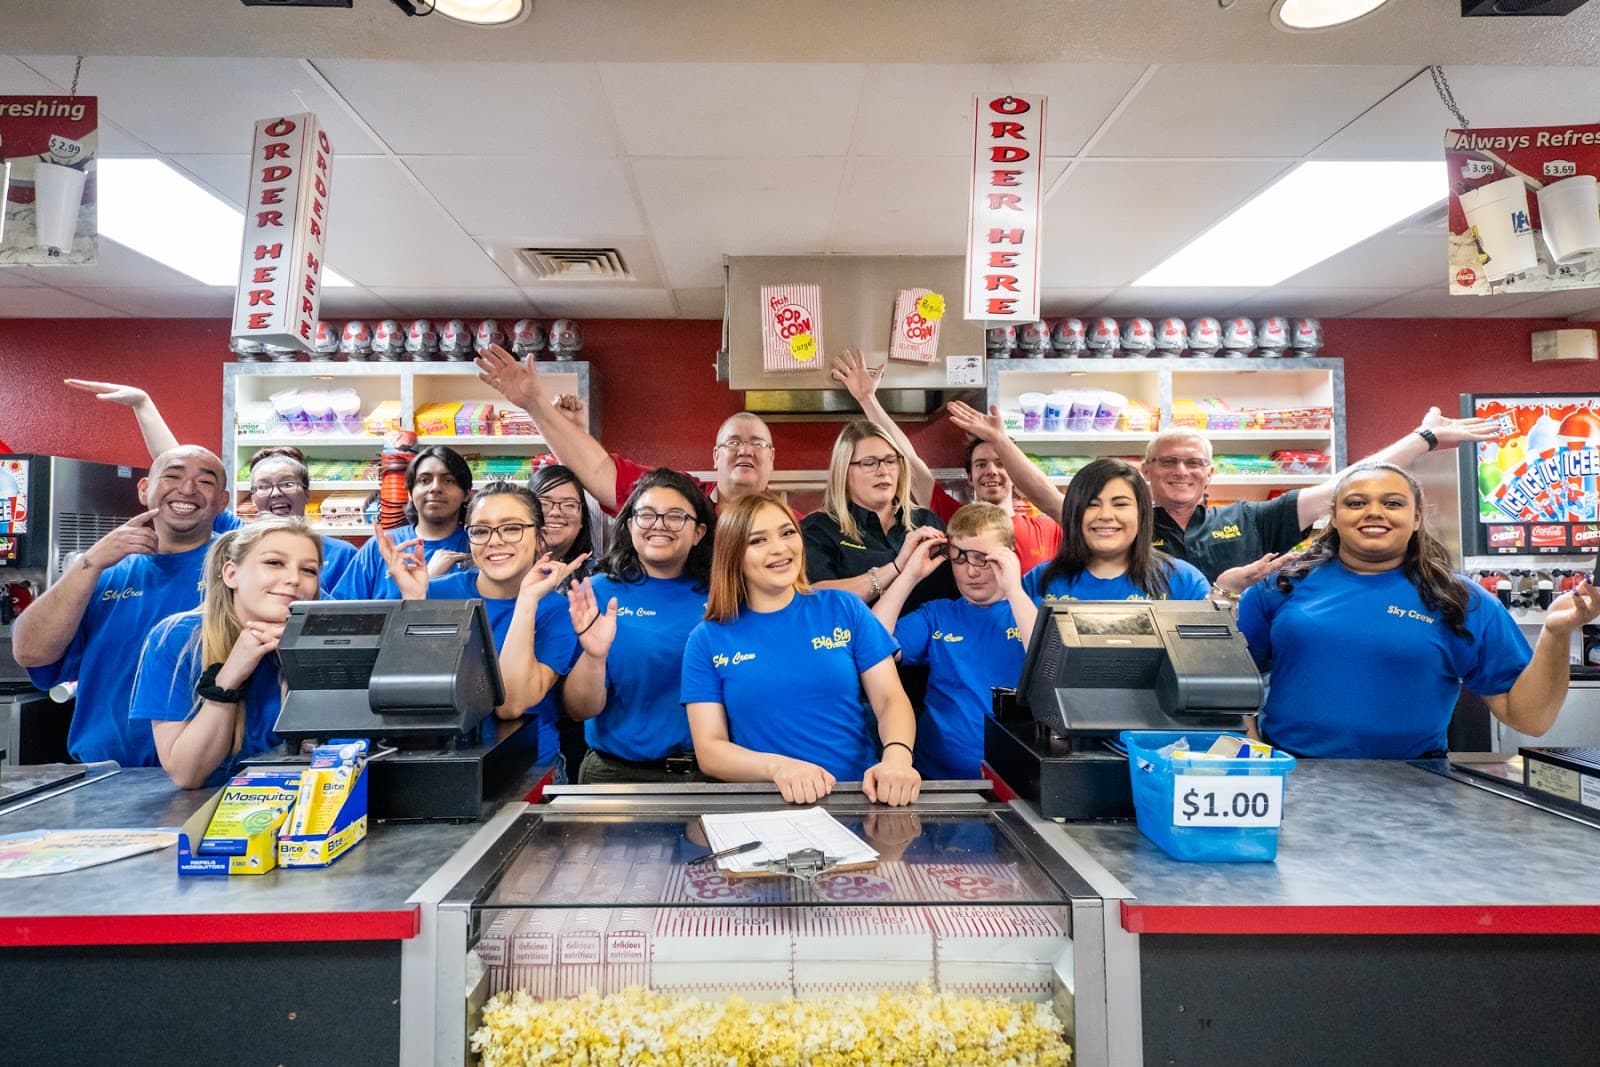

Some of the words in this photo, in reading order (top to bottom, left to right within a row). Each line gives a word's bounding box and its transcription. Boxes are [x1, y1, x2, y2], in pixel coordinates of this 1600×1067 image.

[1456, 133, 1530, 152] Always
[985, 97, 1031, 211] ORDER
[255, 118, 297, 229] ORDER
[310, 130, 330, 244] ORDER
[983, 227, 1025, 314] HERE
[247, 243, 283, 329] HERE
[300, 252, 319, 340] HERE
[776, 308, 801, 327] POP
[906, 313, 927, 328] POP
[781, 318, 811, 339] CORN
[907, 325, 933, 340] CORN
[1387, 605, 1407, 618] Sky
[1408, 609, 1436, 624] Crew
[811, 635, 833, 650] Big
[833, 627, 851, 643] Sky
[713, 653, 729, 668] Sky
[322, 783, 345, 792] Bite
[224, 792, 295, 803] Mosquito
[1182, 788, 1269, 821] $1.00
[280, 845, 304, 854] Bite
[678, 909, 737, 918] DELICIOUS
[814, 909, 872, 918] DELICIOUS
[734, 917, 769, 926] CRISP
[872, 917, 906, 926] CRISP
[518, 941, 548, 950] delicious
[566, 941, 595, 949] delicious
[612, 940, 641, 949] delicious
[516, 952, 549, 960] nutritious
[564, 952, 597, 960] nutritious
[610, 951, 642, 959] nutritious
